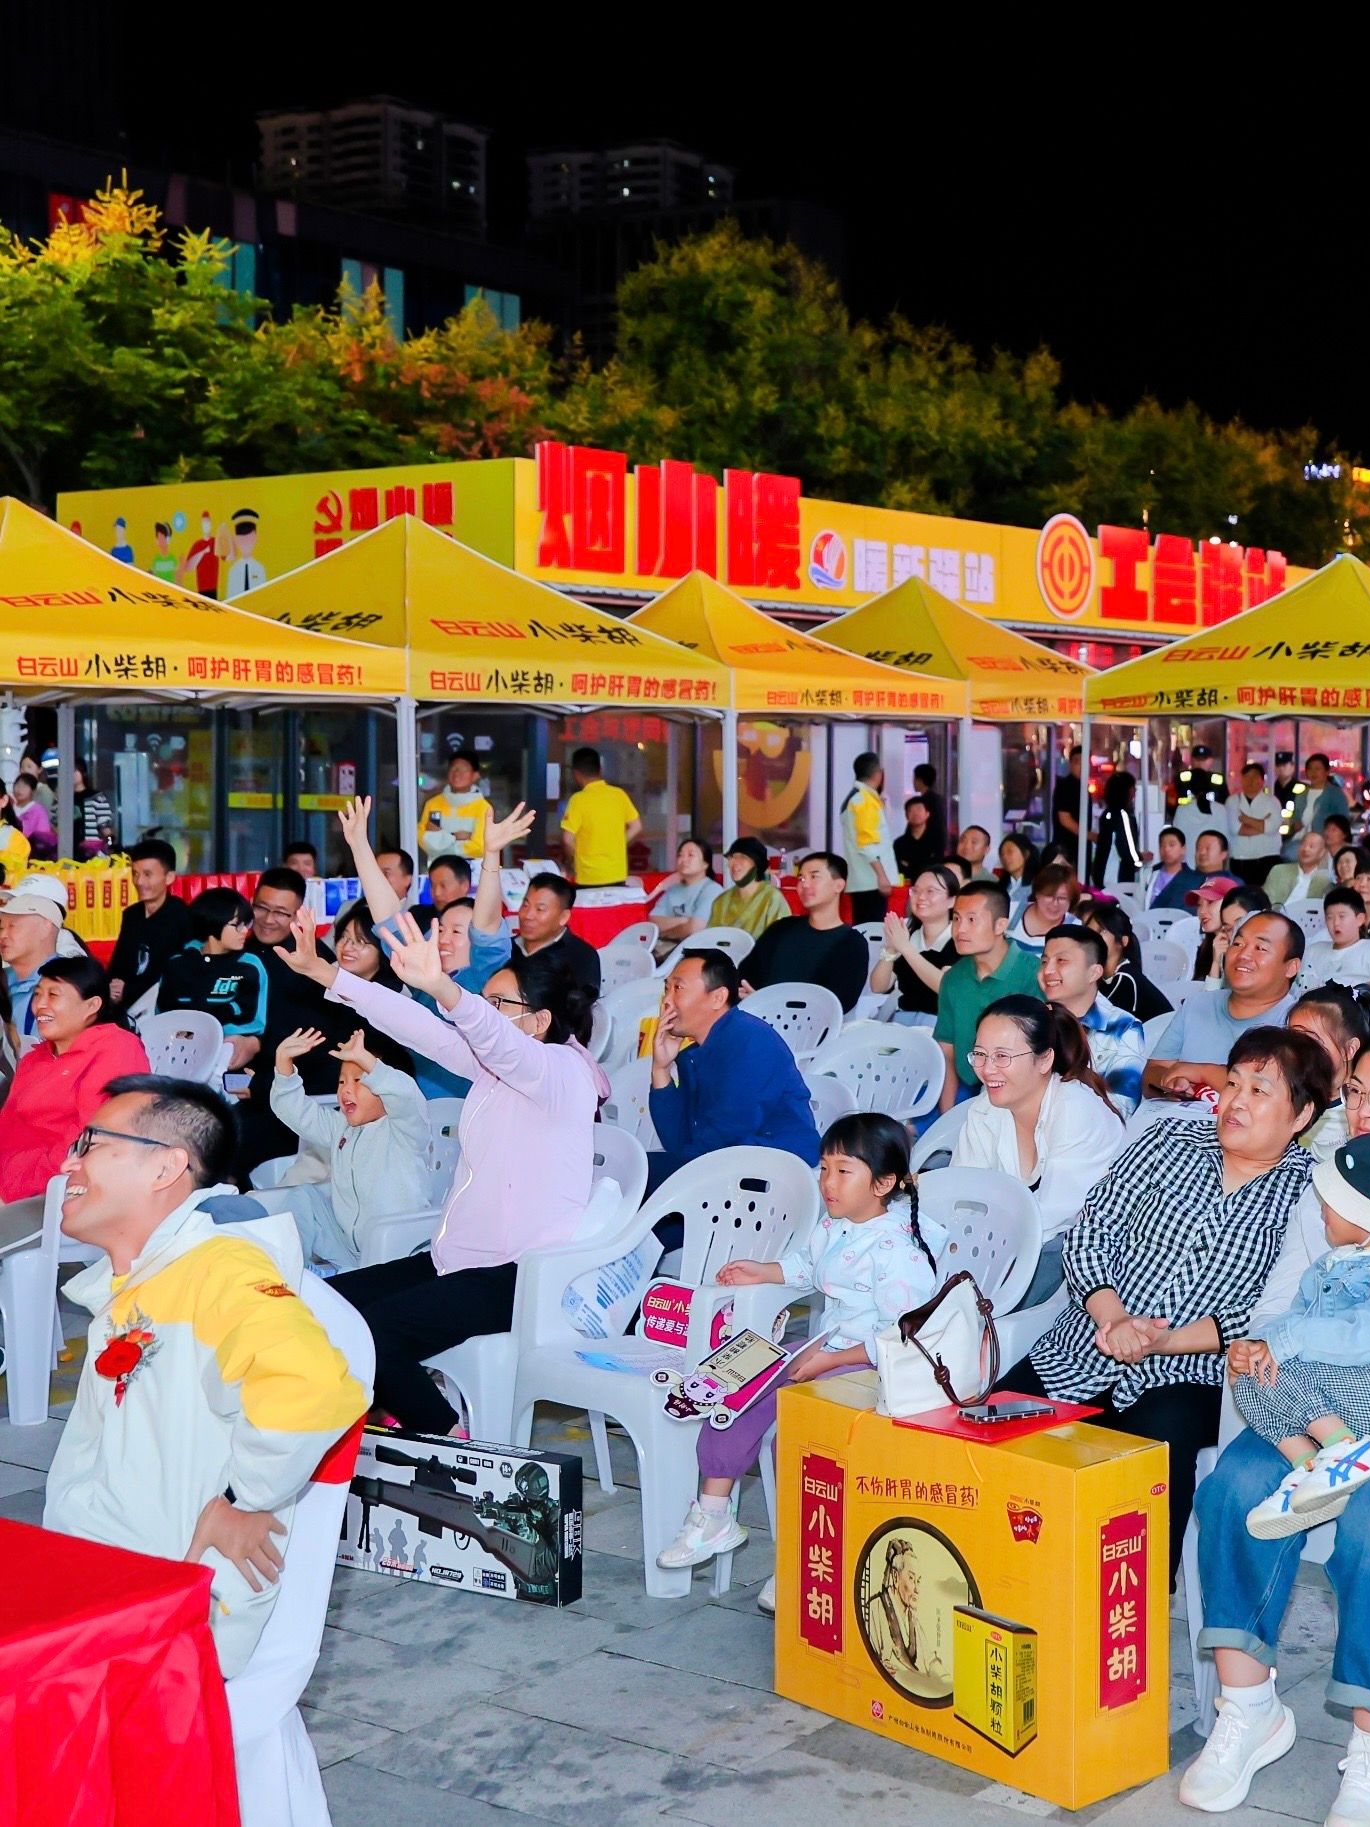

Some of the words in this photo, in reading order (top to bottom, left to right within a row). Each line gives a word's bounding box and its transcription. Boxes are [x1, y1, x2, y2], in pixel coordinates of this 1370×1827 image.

[430, 619, 527, 639] 白云山
[528, 619, 642, 646] 小柴胡
[1162, 645, 1250, 663] 白云山
[16, 656, 79, 678] 白云山
[187, 657, 364, 686] 呵护肝胃的感冒药!
[429, 671, 481, 692] 白云山
[571, 672, 717, 701] 呵护肝胃的感冒药!
[804, 1476, 838, 1502] 白云山
[856, 1476, 979, 1507] 不伤肝胃的感冒药!
[1151, 1485, 1166, 1494] OTC
[1102, 1535, 1142, 1563] 白云山
[808, 1504, 835, 1626] 小柴胡
[1107, 1561, 1138, 1681] 小柴胡
